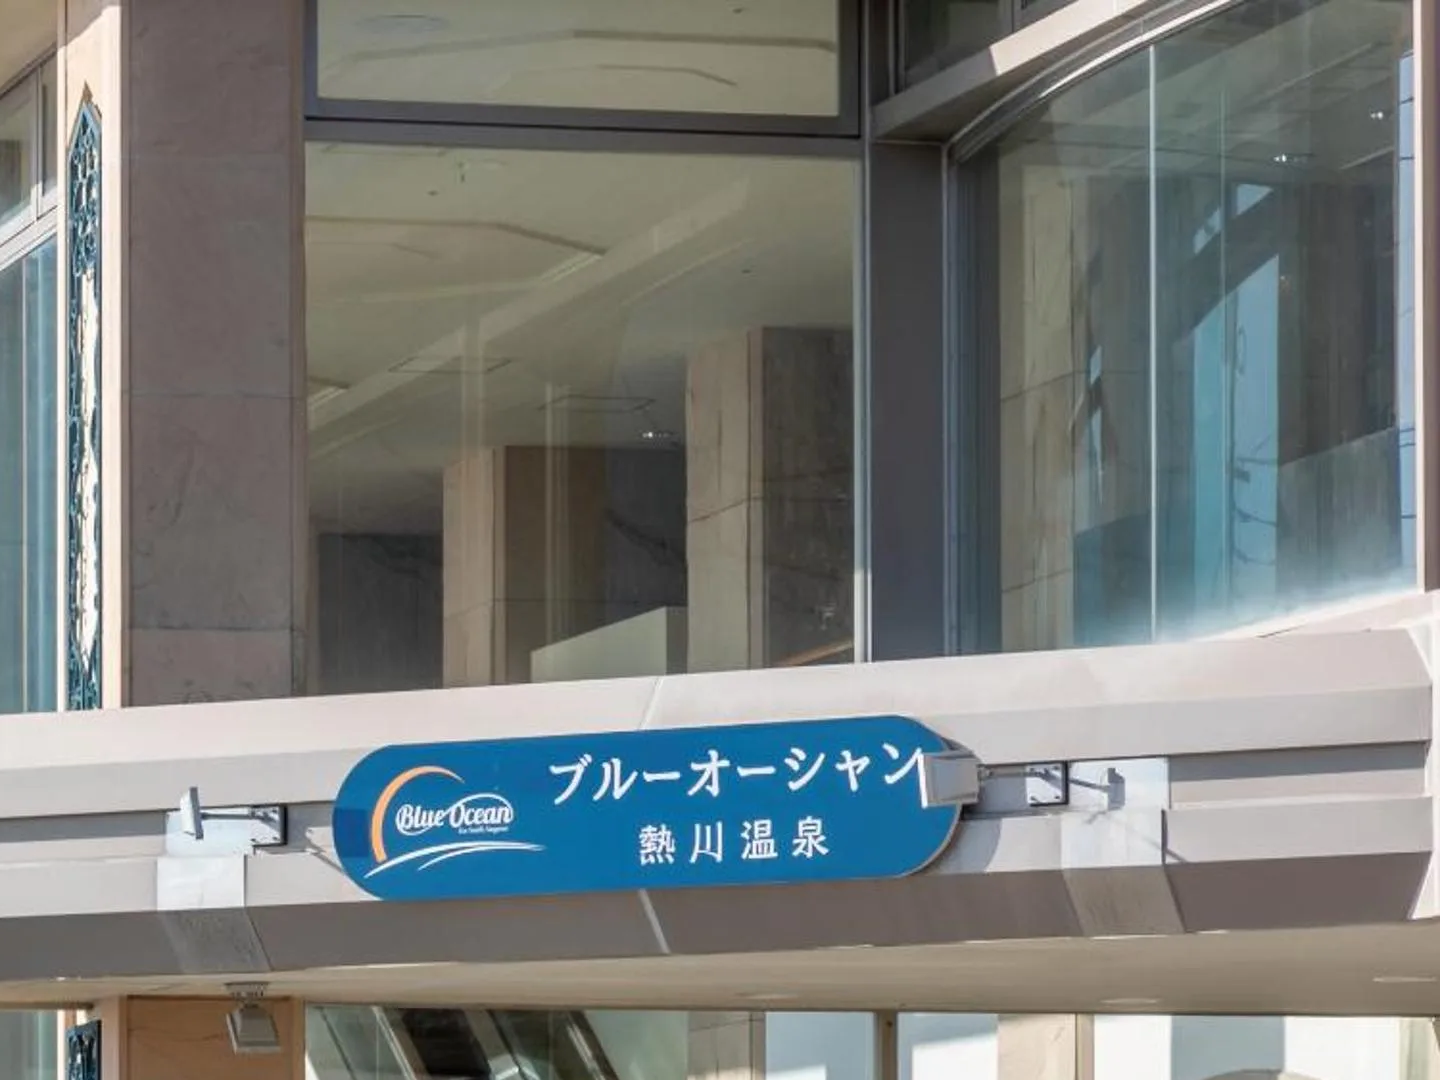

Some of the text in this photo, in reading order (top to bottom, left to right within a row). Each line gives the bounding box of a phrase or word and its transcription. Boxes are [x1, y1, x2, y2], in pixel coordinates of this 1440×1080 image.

[548, 742, 922, 806] ブルーオーシャン
[395, 797, 514, 833] Blue Ocean
[638, 816, 830, 866] 熱川温泉
